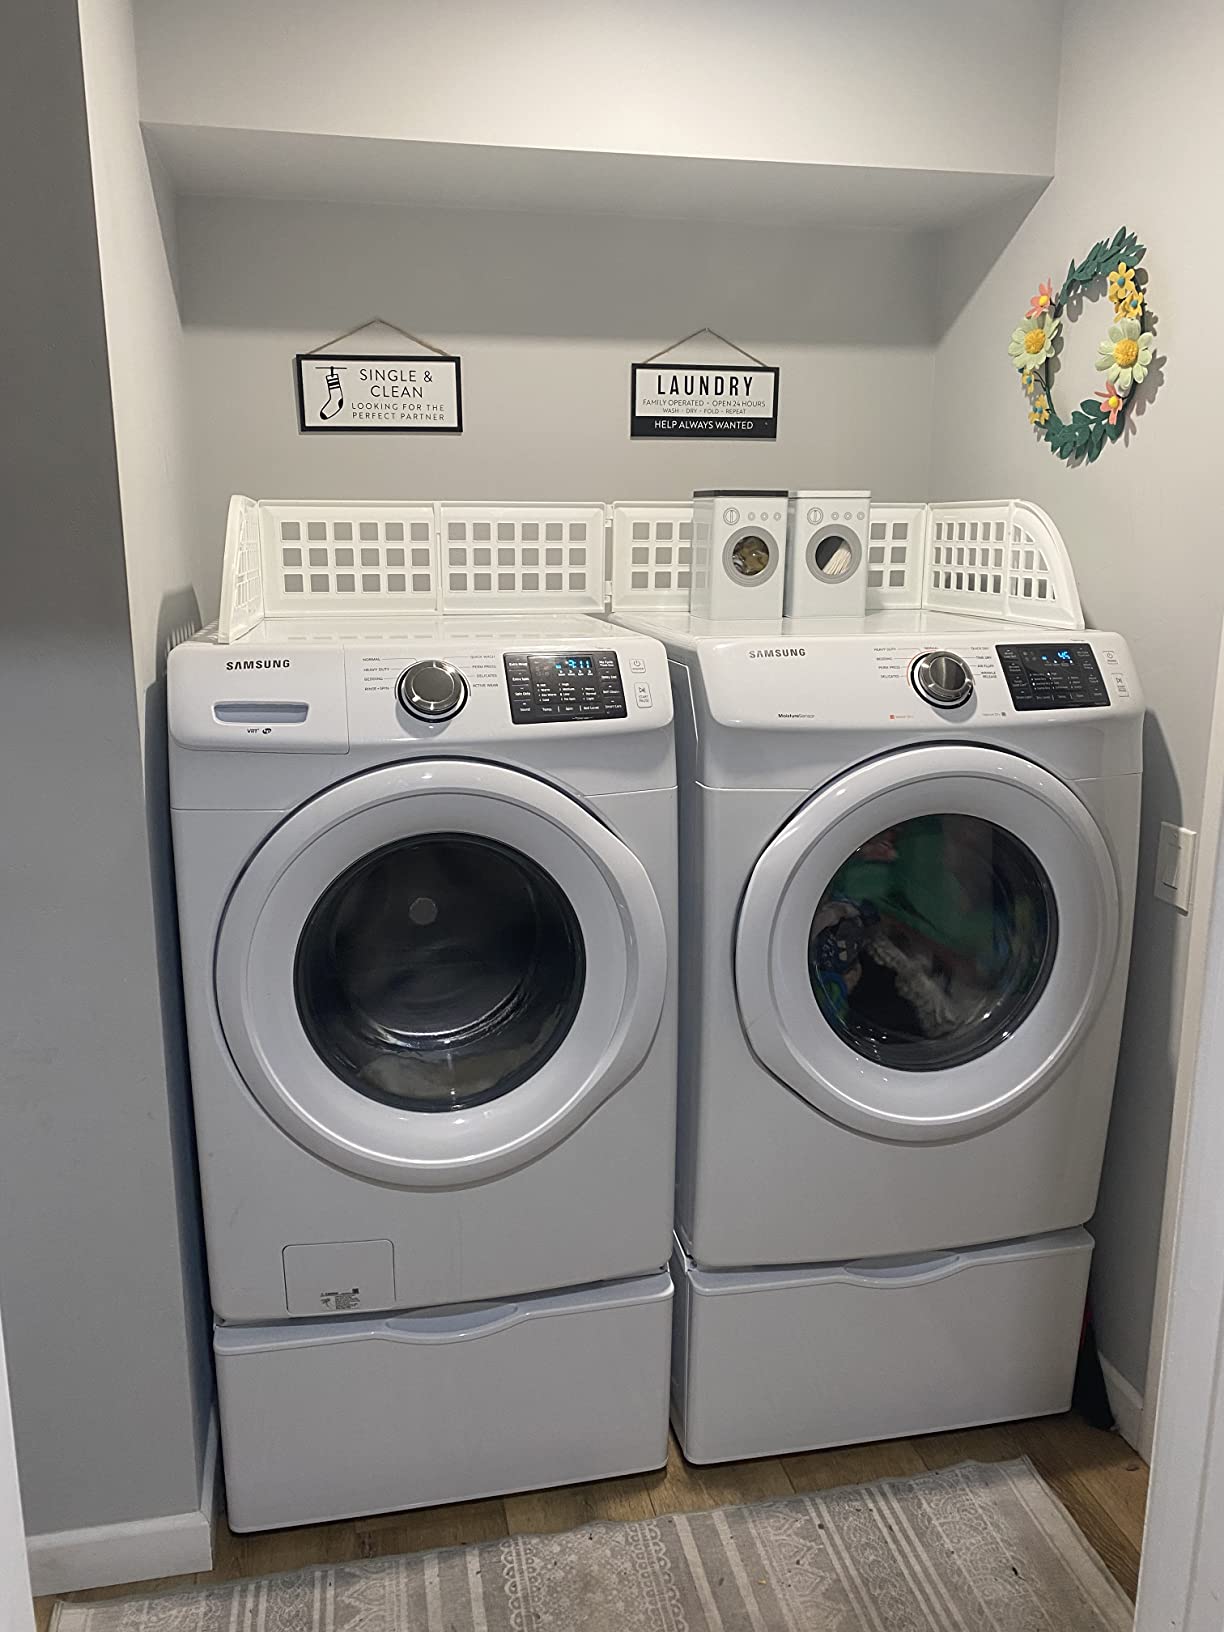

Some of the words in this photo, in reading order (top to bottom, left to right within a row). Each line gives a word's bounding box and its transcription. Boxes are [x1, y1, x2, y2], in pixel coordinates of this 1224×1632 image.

[360, 368, 417, 382] SINGLE
[423, 370, 433, 382] &
[657, 374, 753, 396] LAUNDRY
[370, 385, 423, 398] CLEAN
[352, 402, 399, 411] LOOKING
[352, 412, 396, 420] PERFECT
[400, 412, 445, 420] PARTNER
[654, 420, 678, 429] HELP
[678, 420, 714, 430] ALWAYS
[715, 421, 754, 430] WANTED
[748, 648, 806, 659] SAMSUNG
[226, 659, 290, 670] SAMSUNG
